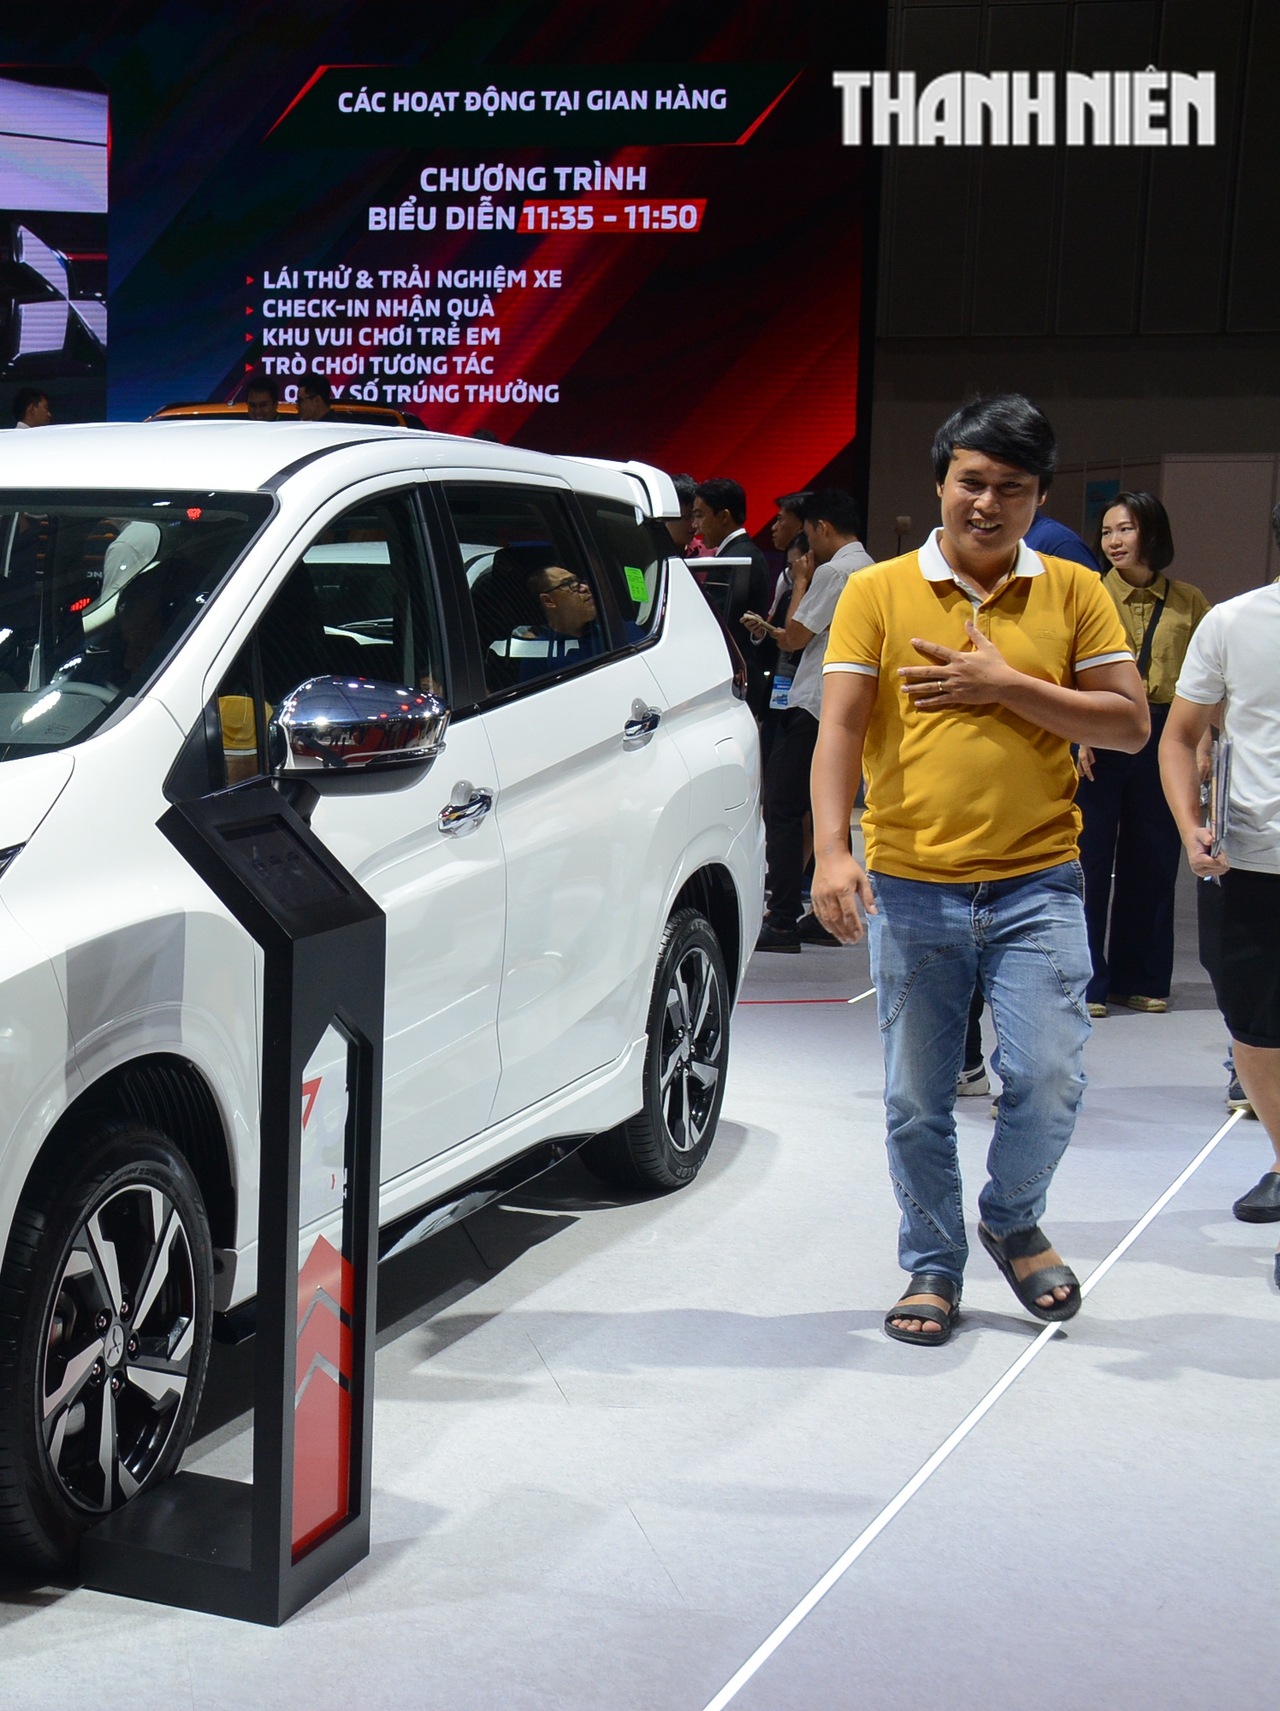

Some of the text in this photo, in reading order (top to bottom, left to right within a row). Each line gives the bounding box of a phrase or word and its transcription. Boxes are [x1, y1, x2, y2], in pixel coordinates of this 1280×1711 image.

[338, 84, 727, 117] CÁC HOẠT ĐỘNG TẠI GIAN HÀNG
[420, 160, 646, 193] CHƯƠNG TRÌNH
[368, 195, 436, 231] BIỂU
[446, 196, 515, 230] DIỄN
[523, 205, 594, 230] 11:35
[624, 205, 698, 230] 11:50
[263, 264, 562, 293] LÁI THỬ & TRẢI NGHIỆM XE
[262, 294, 495, 322] CHECK-IN NHẬN QUÀ
[262, 322, 500, 346] KHU VUI CHƠI TRẺ EM
[262, 352, 494, 375] TRÒ CHƠI TƯƠNG TÁC
[349, 378, 380, 402] SỐ
[382, 380, 459, 403] TRÚNG
[464, 379, 560, 403] THƯỞNG
